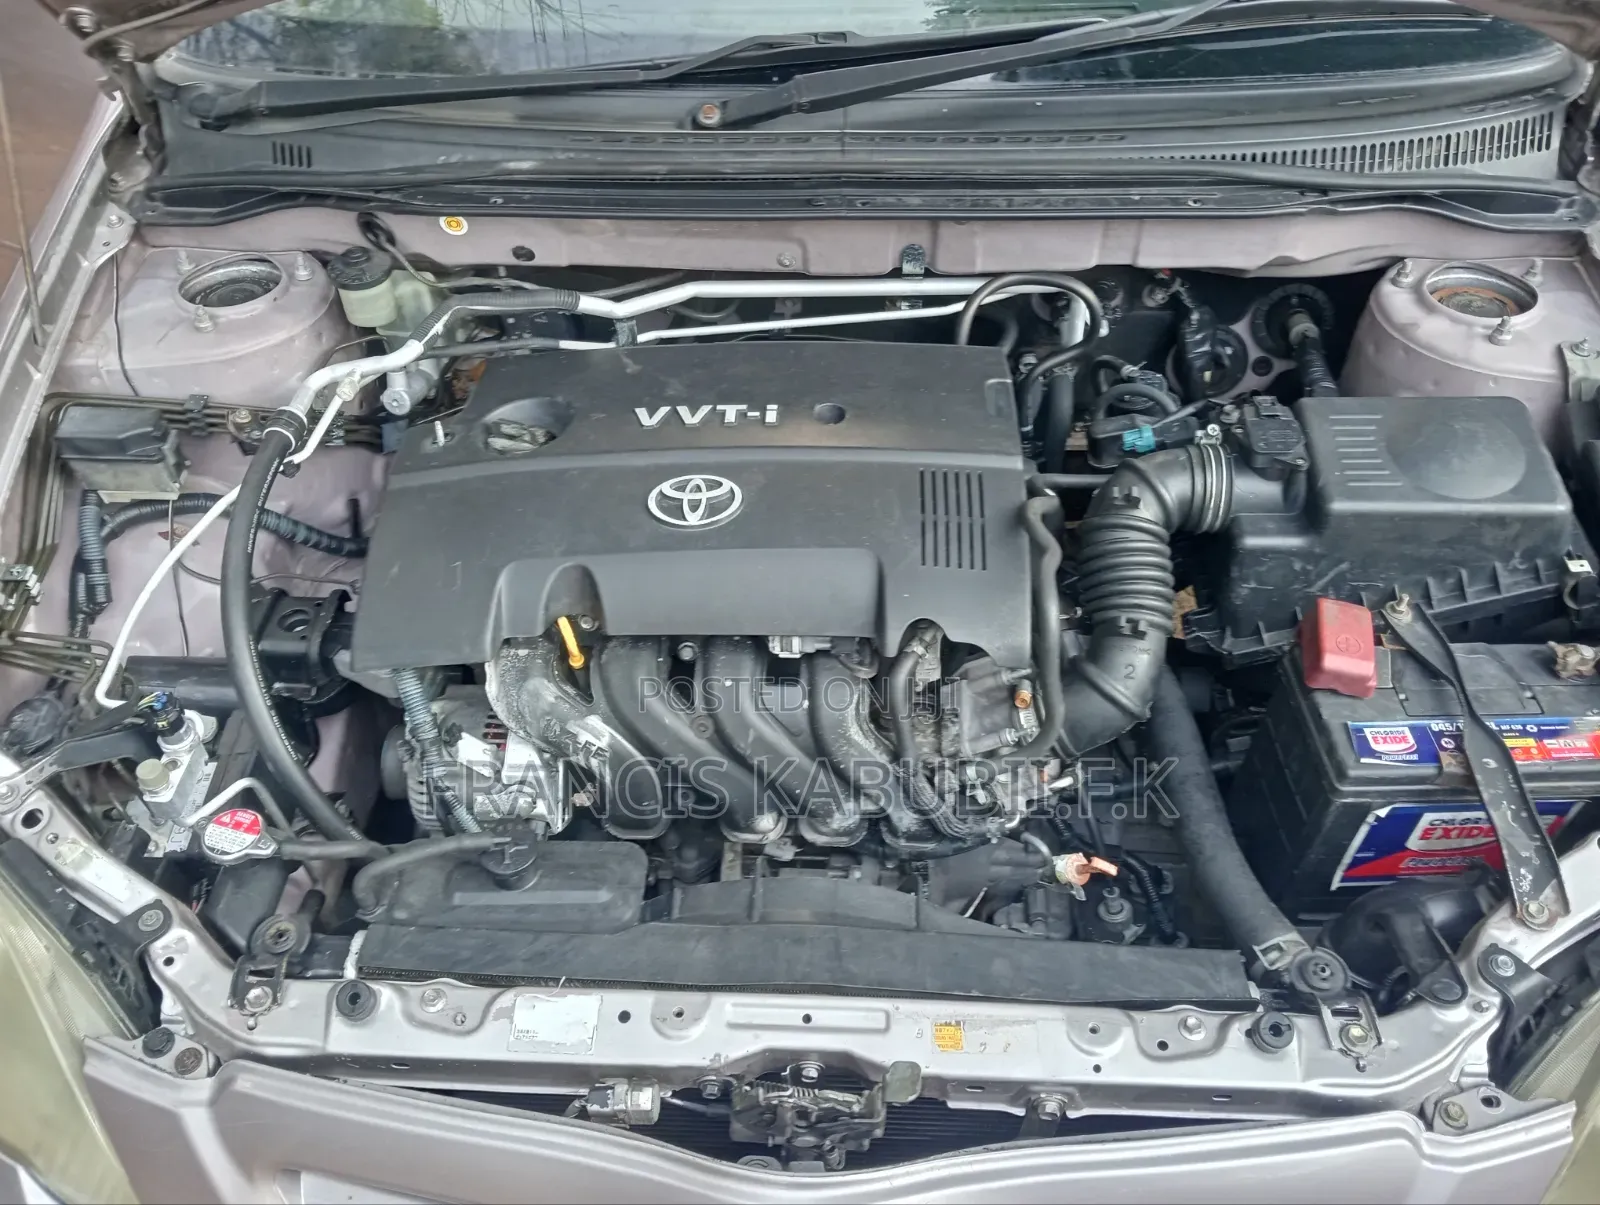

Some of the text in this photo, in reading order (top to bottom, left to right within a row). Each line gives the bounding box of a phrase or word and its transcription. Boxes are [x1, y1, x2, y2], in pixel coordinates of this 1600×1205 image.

[633, 404, 779, 428] VVT-i
[1123, 664, 1136, 680] 2
[1371, 735, 1411, 745] EXIDE
